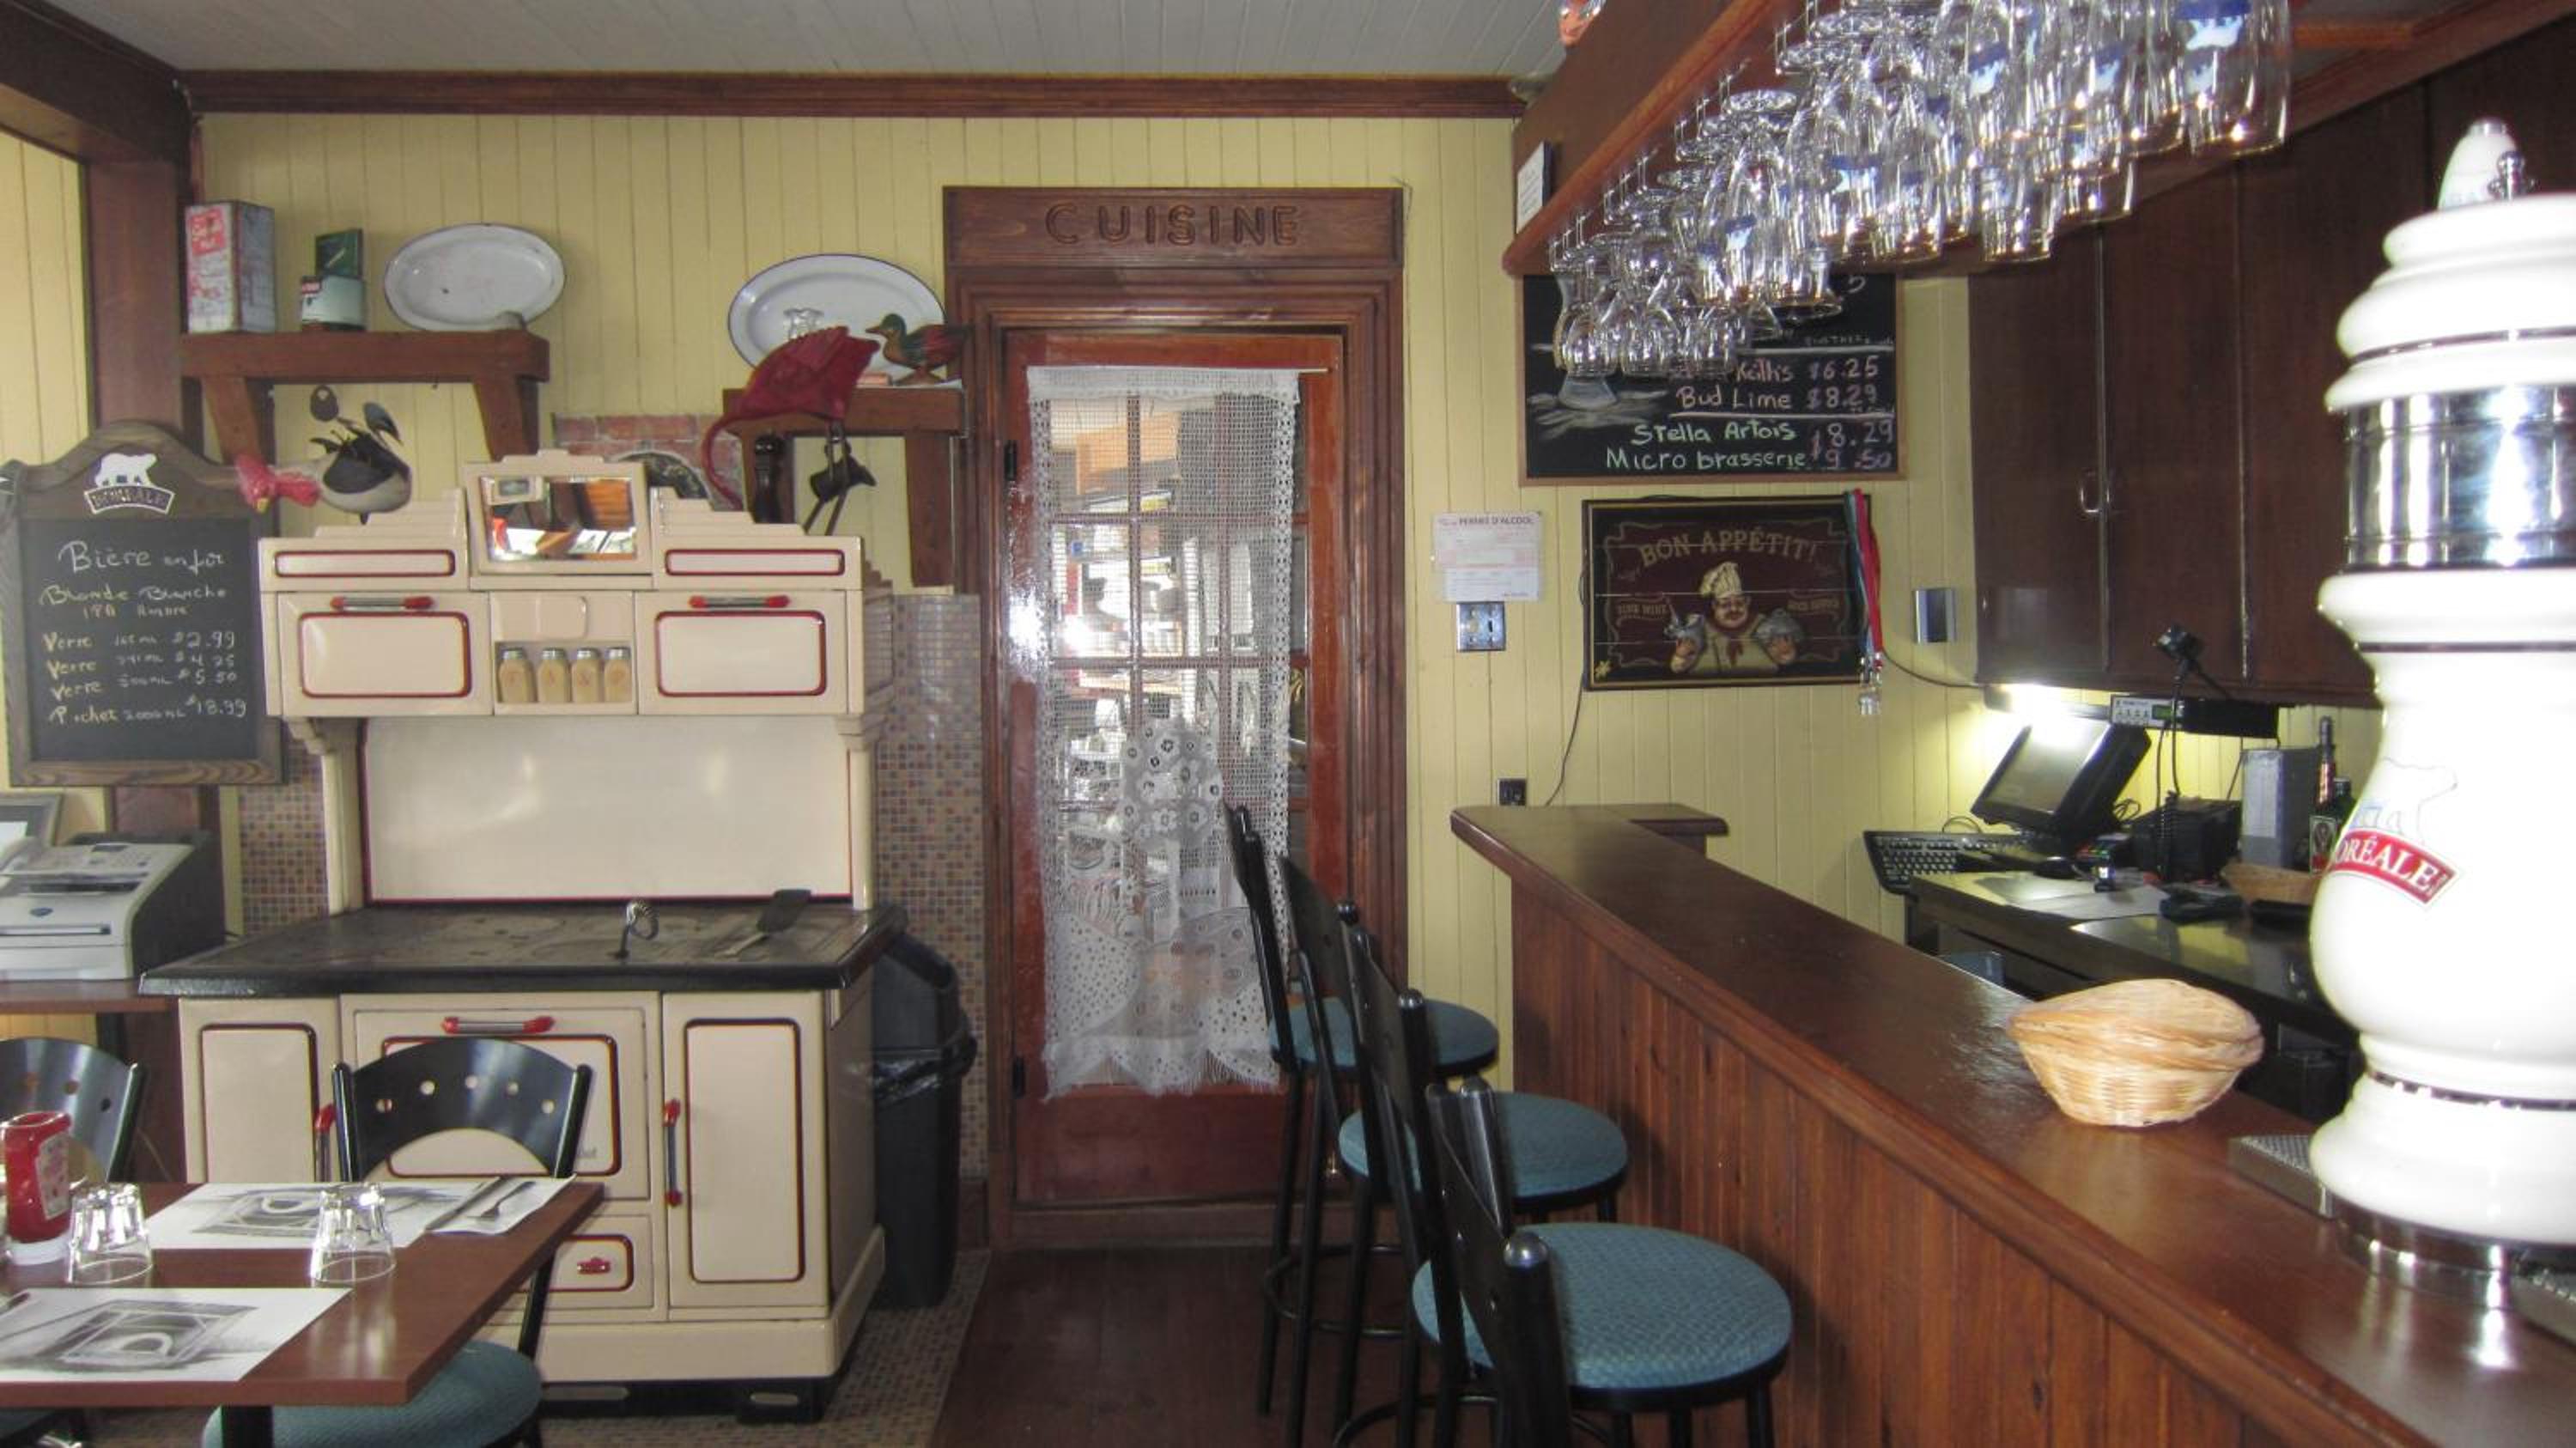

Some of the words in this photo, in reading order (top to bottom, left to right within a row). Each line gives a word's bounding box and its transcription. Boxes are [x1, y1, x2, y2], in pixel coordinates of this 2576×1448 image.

[1045, 204, 1298, 246] CUISINE
[1676, 384, 1722, 409] Bud
[1733, 387, 1792, 409] Lime
[1631, 421, 1711, 445] Stella
[1724, 419, 1796, 441] Artois
[1607, 447, 1686, 470] Micro
[1697, 450, 1806, 470] brasserie
[1639, 532, 1690, 567] BON
[43, 632, 93, 653] Verre
[46, 660, 96, 679] Verre
[51, 681, 103, 701] Verre
[2336, 834, 2439, 891] ORÉALE
